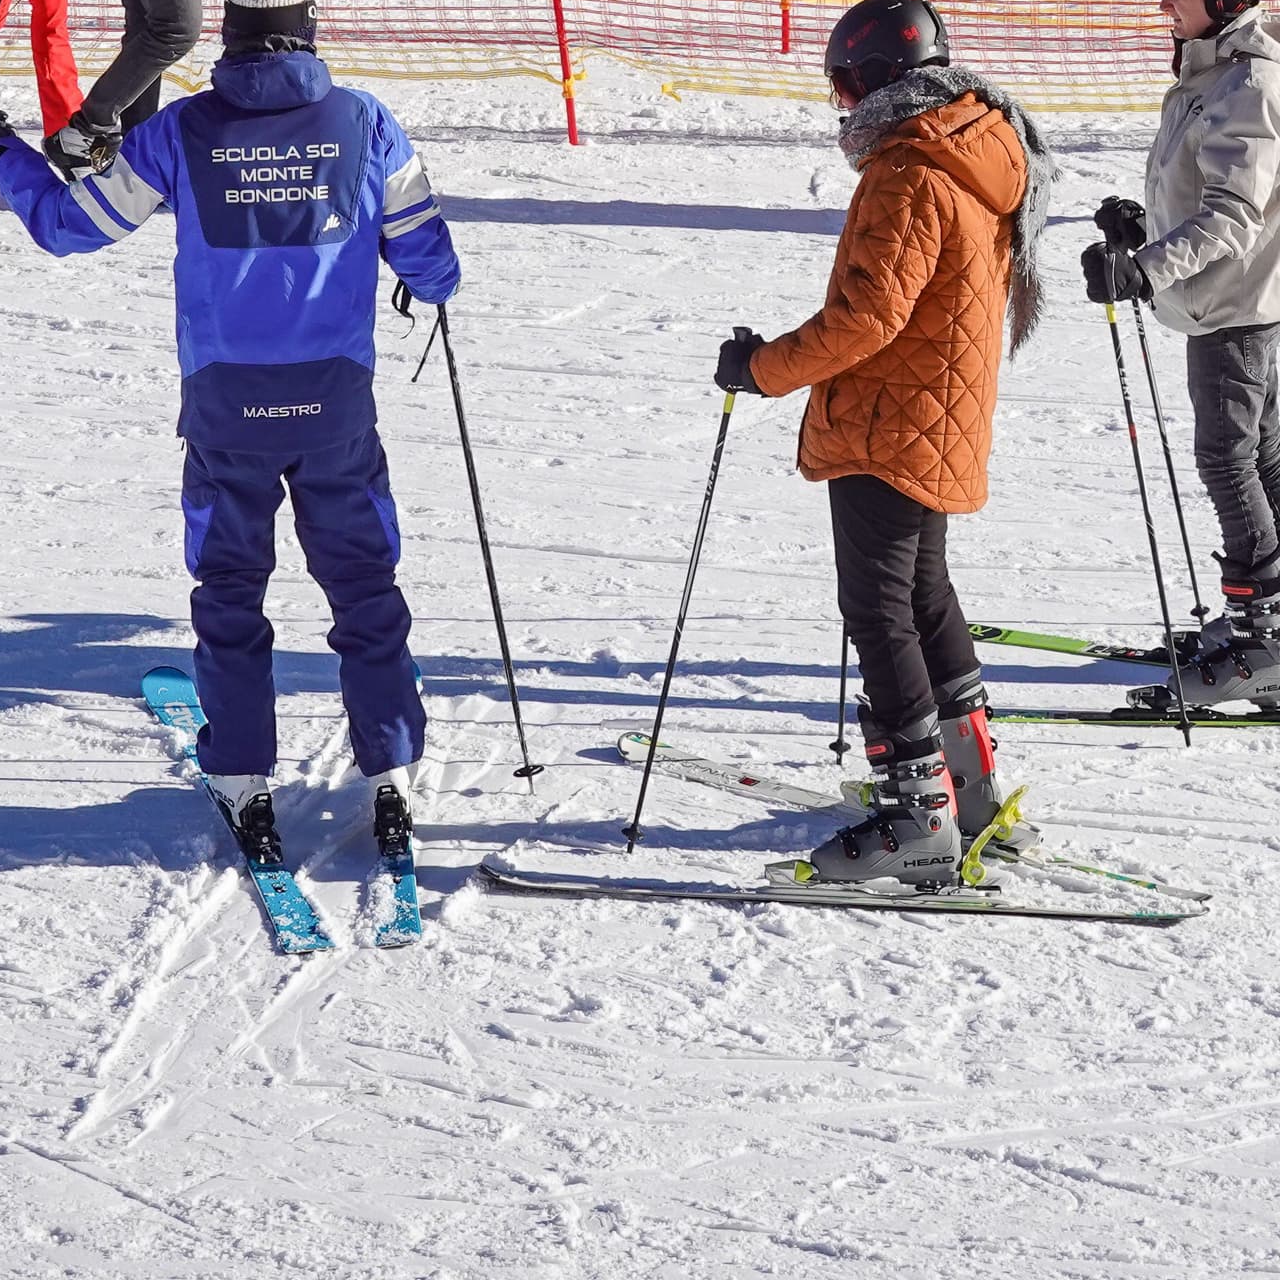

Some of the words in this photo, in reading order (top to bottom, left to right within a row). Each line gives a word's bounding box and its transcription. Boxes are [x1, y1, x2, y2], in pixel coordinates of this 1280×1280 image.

[211, 145, 301, 163] SCUOLA
[306, 143, 340, 158] SCI
[240, 165, 313, 182] MONTE
[225, 185, 329, 203] BONDONE
[243, 403, 321, 419] MAESTRO
[903, 855, 955, 868] HEAD
